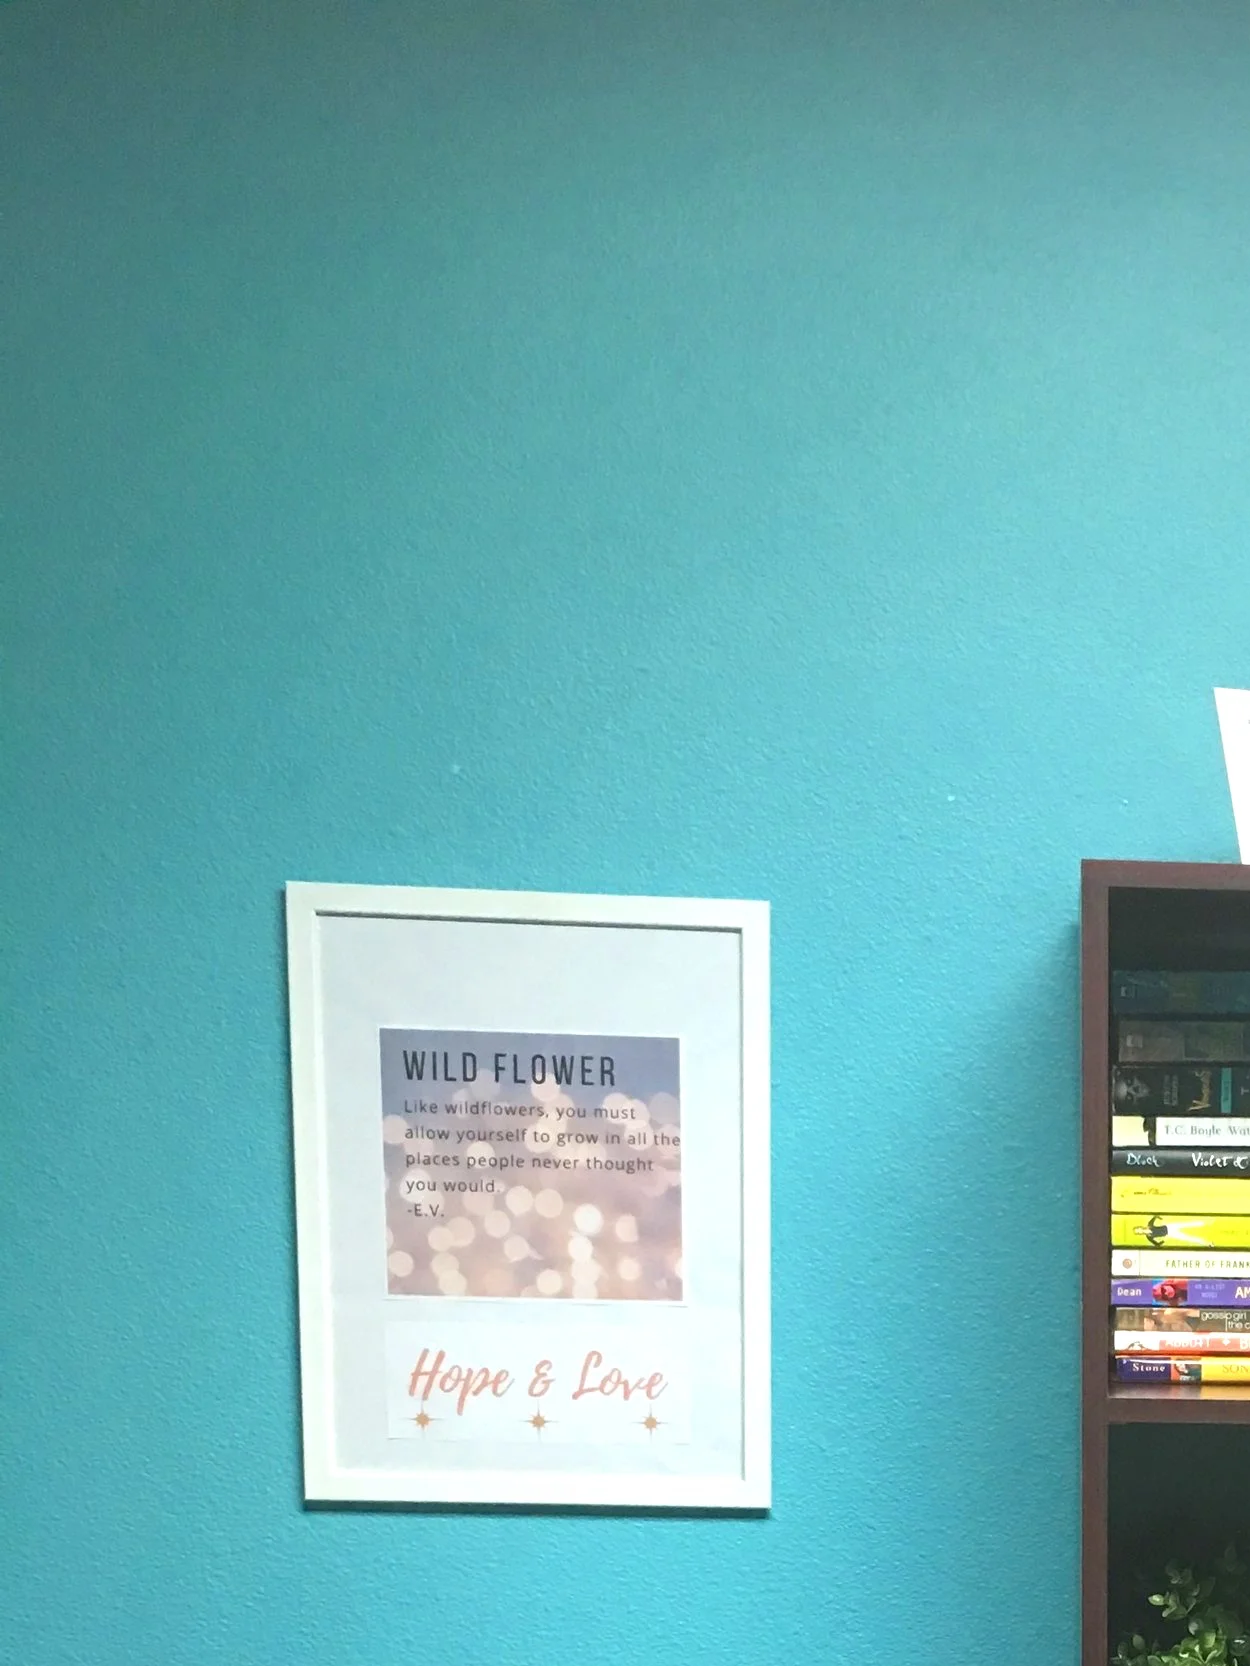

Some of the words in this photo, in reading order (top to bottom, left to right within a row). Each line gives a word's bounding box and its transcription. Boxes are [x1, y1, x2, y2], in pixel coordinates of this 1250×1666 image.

[404, 1048, 478, 1084] WILD
[494, 1052, 617, 1087] FLOWER
[405, 1100, 439, 1115] Like
[445, 1101, 549, 1119] wildflowers,
[556, 1106, 587, 1123] you
[594, 1105, 636, 1120] must
[405, 1126, 451, 1142] allow
[457, 1129, 527, 1147] yourself
[533, 1131, 550, 1144] to
[556, 1134, 599, 1150] grow
[606, 1132, 622, 1145] in
[628, 1132, 648, 1146] all
[654, 1132, 680, 1146] the
[406, 1151, 460, 1171] places
[467, 1153, 525, 1173] people
[532, 1157, 579, 1170] never
[586, 1156, 654, 1176] thought
[1192, 1153, 1229, 1168] Violet
[406, 1180, 436, 1196] you
[443, 1179, 500, 1194] would.
[407, 1203, 444, 1218] -E.V.
[1166, 1259, 1201, 1270] FATHER
[1205, 1260, 1216, 1270] OF
[1118, 1288, 1141, 1296] Dean
[1201, 1312, 1231, 1321] gossip
[1234, 1311, 1247, 1320] girl
[1228, 1320, 1242, 1329] the
[1133, 1363, 1165, 1372] Stone
[408, 1348, 514, 1416] Hope
[527, 1358, 555, 1396] &
[573, 1350, 668, 1399] Love
